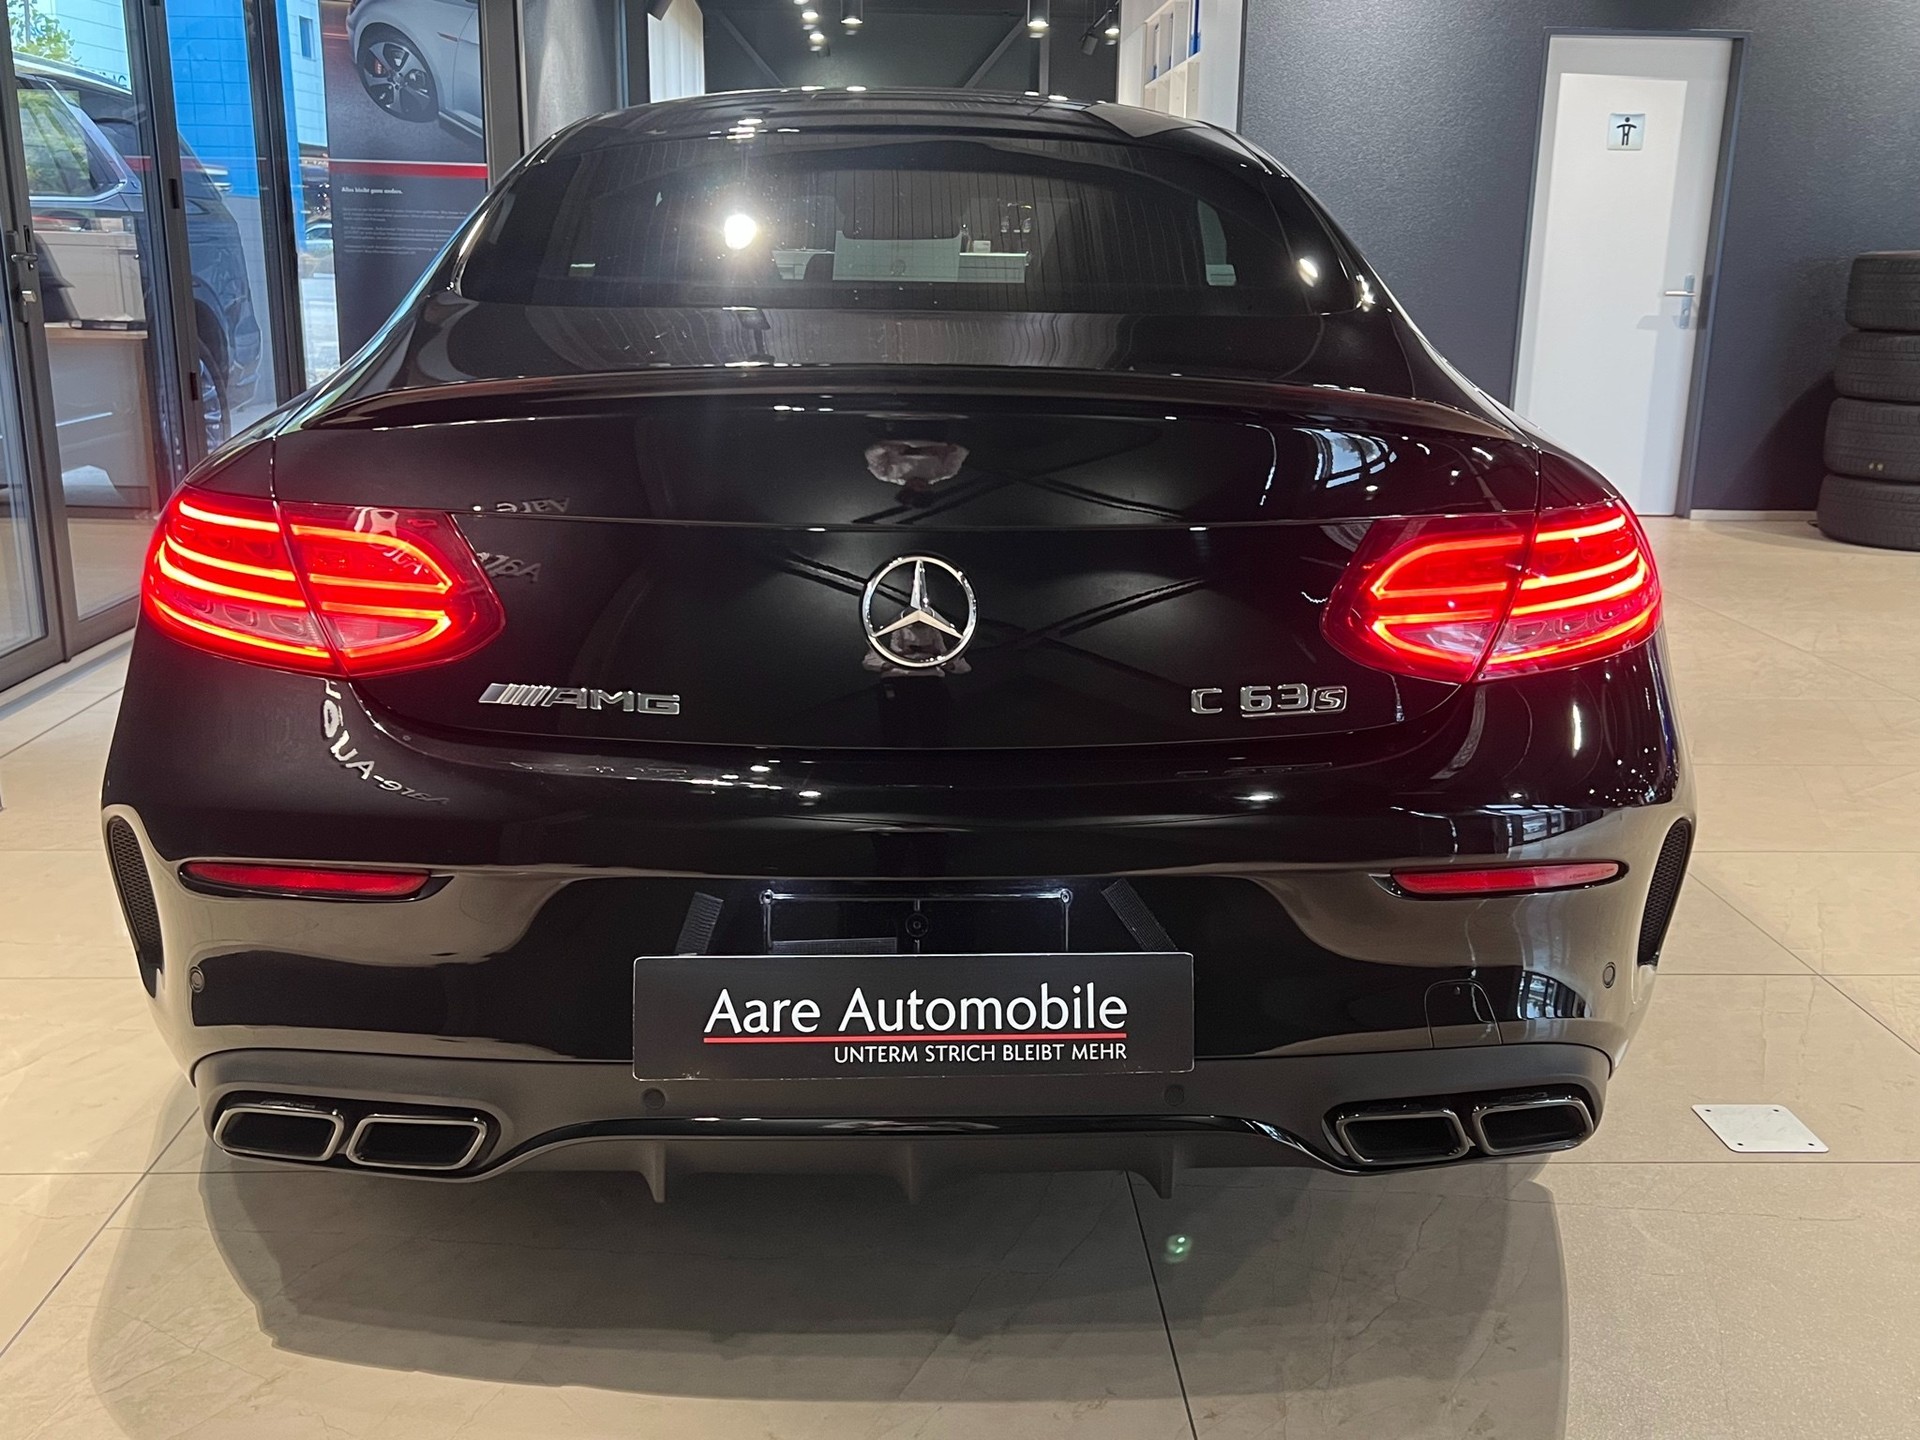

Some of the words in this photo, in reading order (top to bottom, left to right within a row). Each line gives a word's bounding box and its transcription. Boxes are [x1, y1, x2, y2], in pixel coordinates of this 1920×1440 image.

[541, 684, 681, 715] AMG
[1190, 688, 1223, 714] C
[703, 988, 821, 1034] Aare
[837, 982, 1128, 1033] Automobile
[833, 1045, 918, 1063] UNTERM
[925, 1044, 996, 1062] STRICH
[1002, 1044, 1064, 1061] BLEIBT
[1071, 1043, 1127, 1060] MEHR
